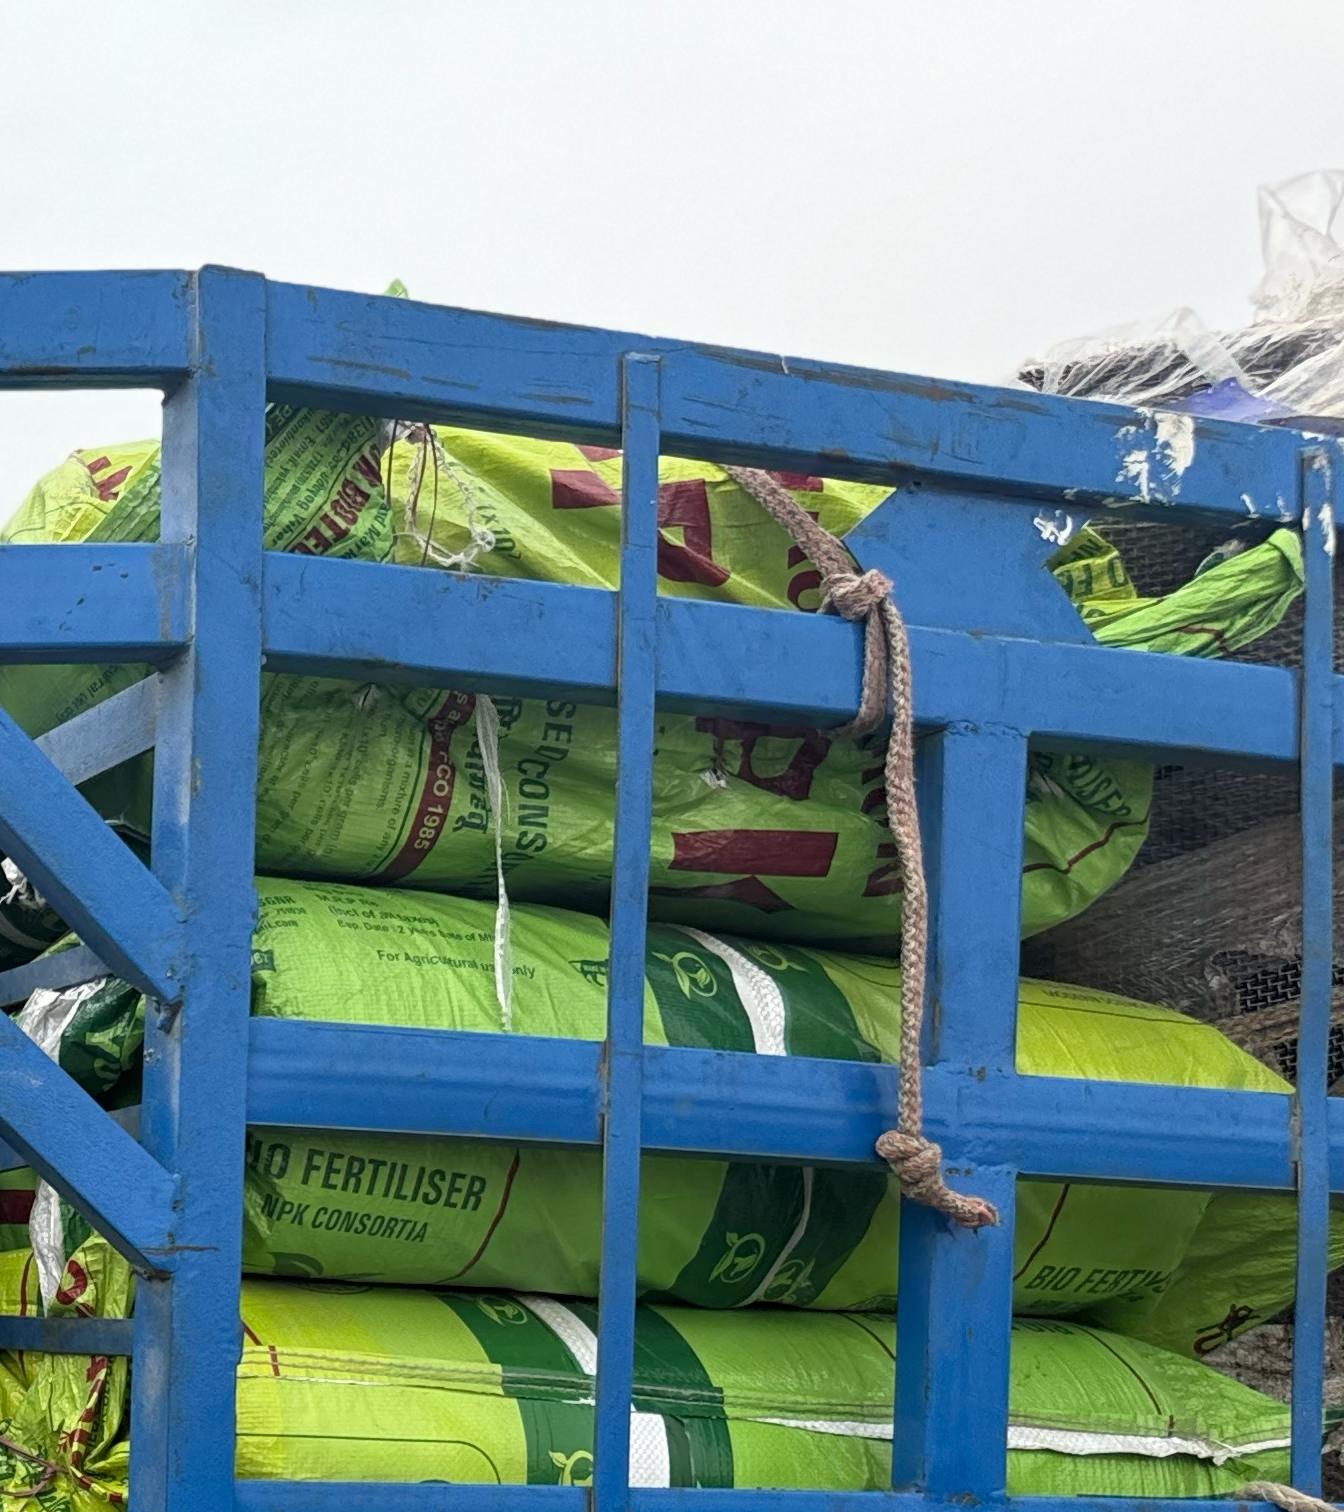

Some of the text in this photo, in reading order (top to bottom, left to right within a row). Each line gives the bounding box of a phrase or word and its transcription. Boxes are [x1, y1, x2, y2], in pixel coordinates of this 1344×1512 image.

[343, 787, 355, 809] per
[393, 771, 410, 815] mixture
[388, 817, 397, 831] of
[414, 804, 444, 850] 1985
[377, 949, 401, 962] For
[404, 951, 479, 971] Agricultural
[301, 1147, 487, 1212] FERTILISER
[261, 1192, 429, 1243] NPK CONSORTIA
[1024, 1264, 1082, 1292] BIO
